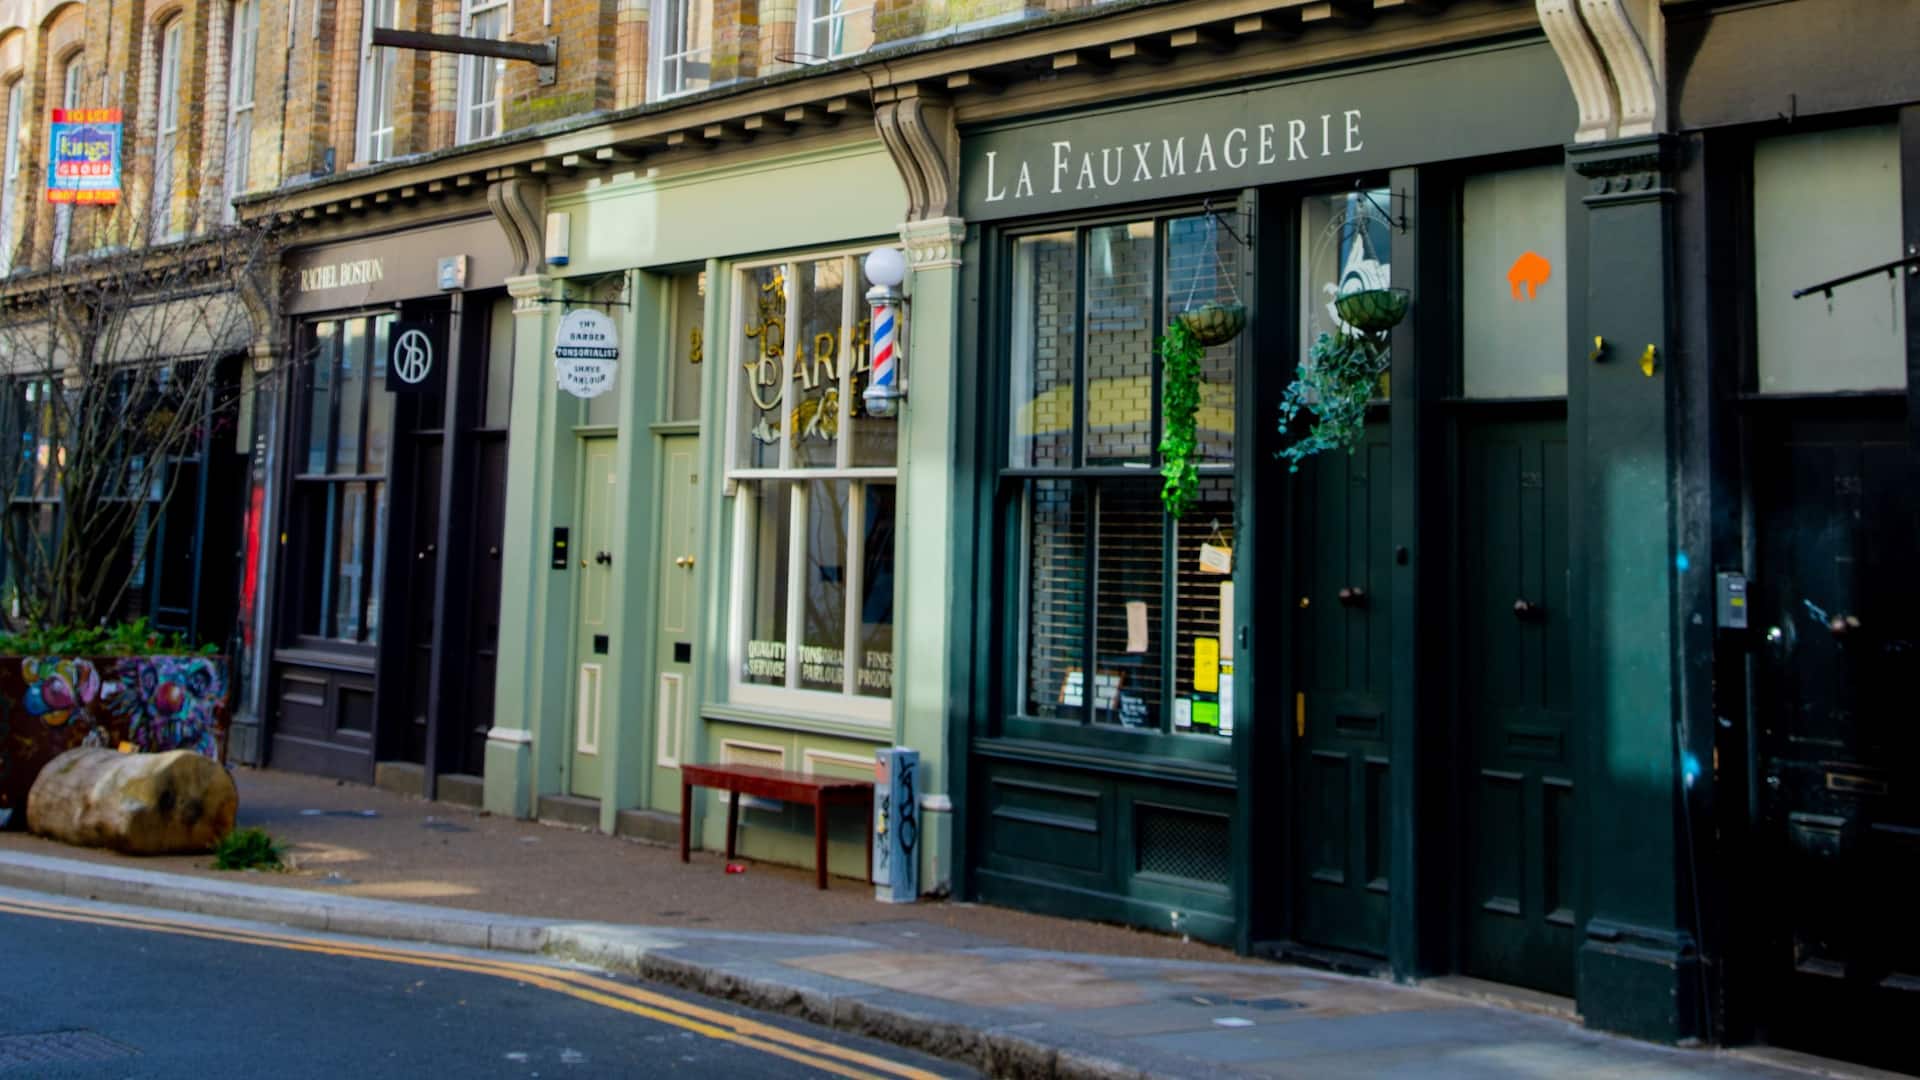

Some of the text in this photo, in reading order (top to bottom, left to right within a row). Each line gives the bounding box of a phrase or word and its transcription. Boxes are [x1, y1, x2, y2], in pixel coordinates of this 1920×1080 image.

[60, 135, 109, 161] kings
[985, 108, 1364, 203] LA FAUXMAGERIE
[59, 164, 109, 175] GROUP
[300, 257, 384, 293] RACHEL BOSTON
[569, 332, 606, 342] BARBER
[557, 347, 617, 358] TONSORIALIST
[574, 365, 601, 373] SHAVE
[567, 371, 607, 385] PARLOUR
[748, 639, 786, 660] QUALITY
[748, 659, 785, 677] SERVICE
